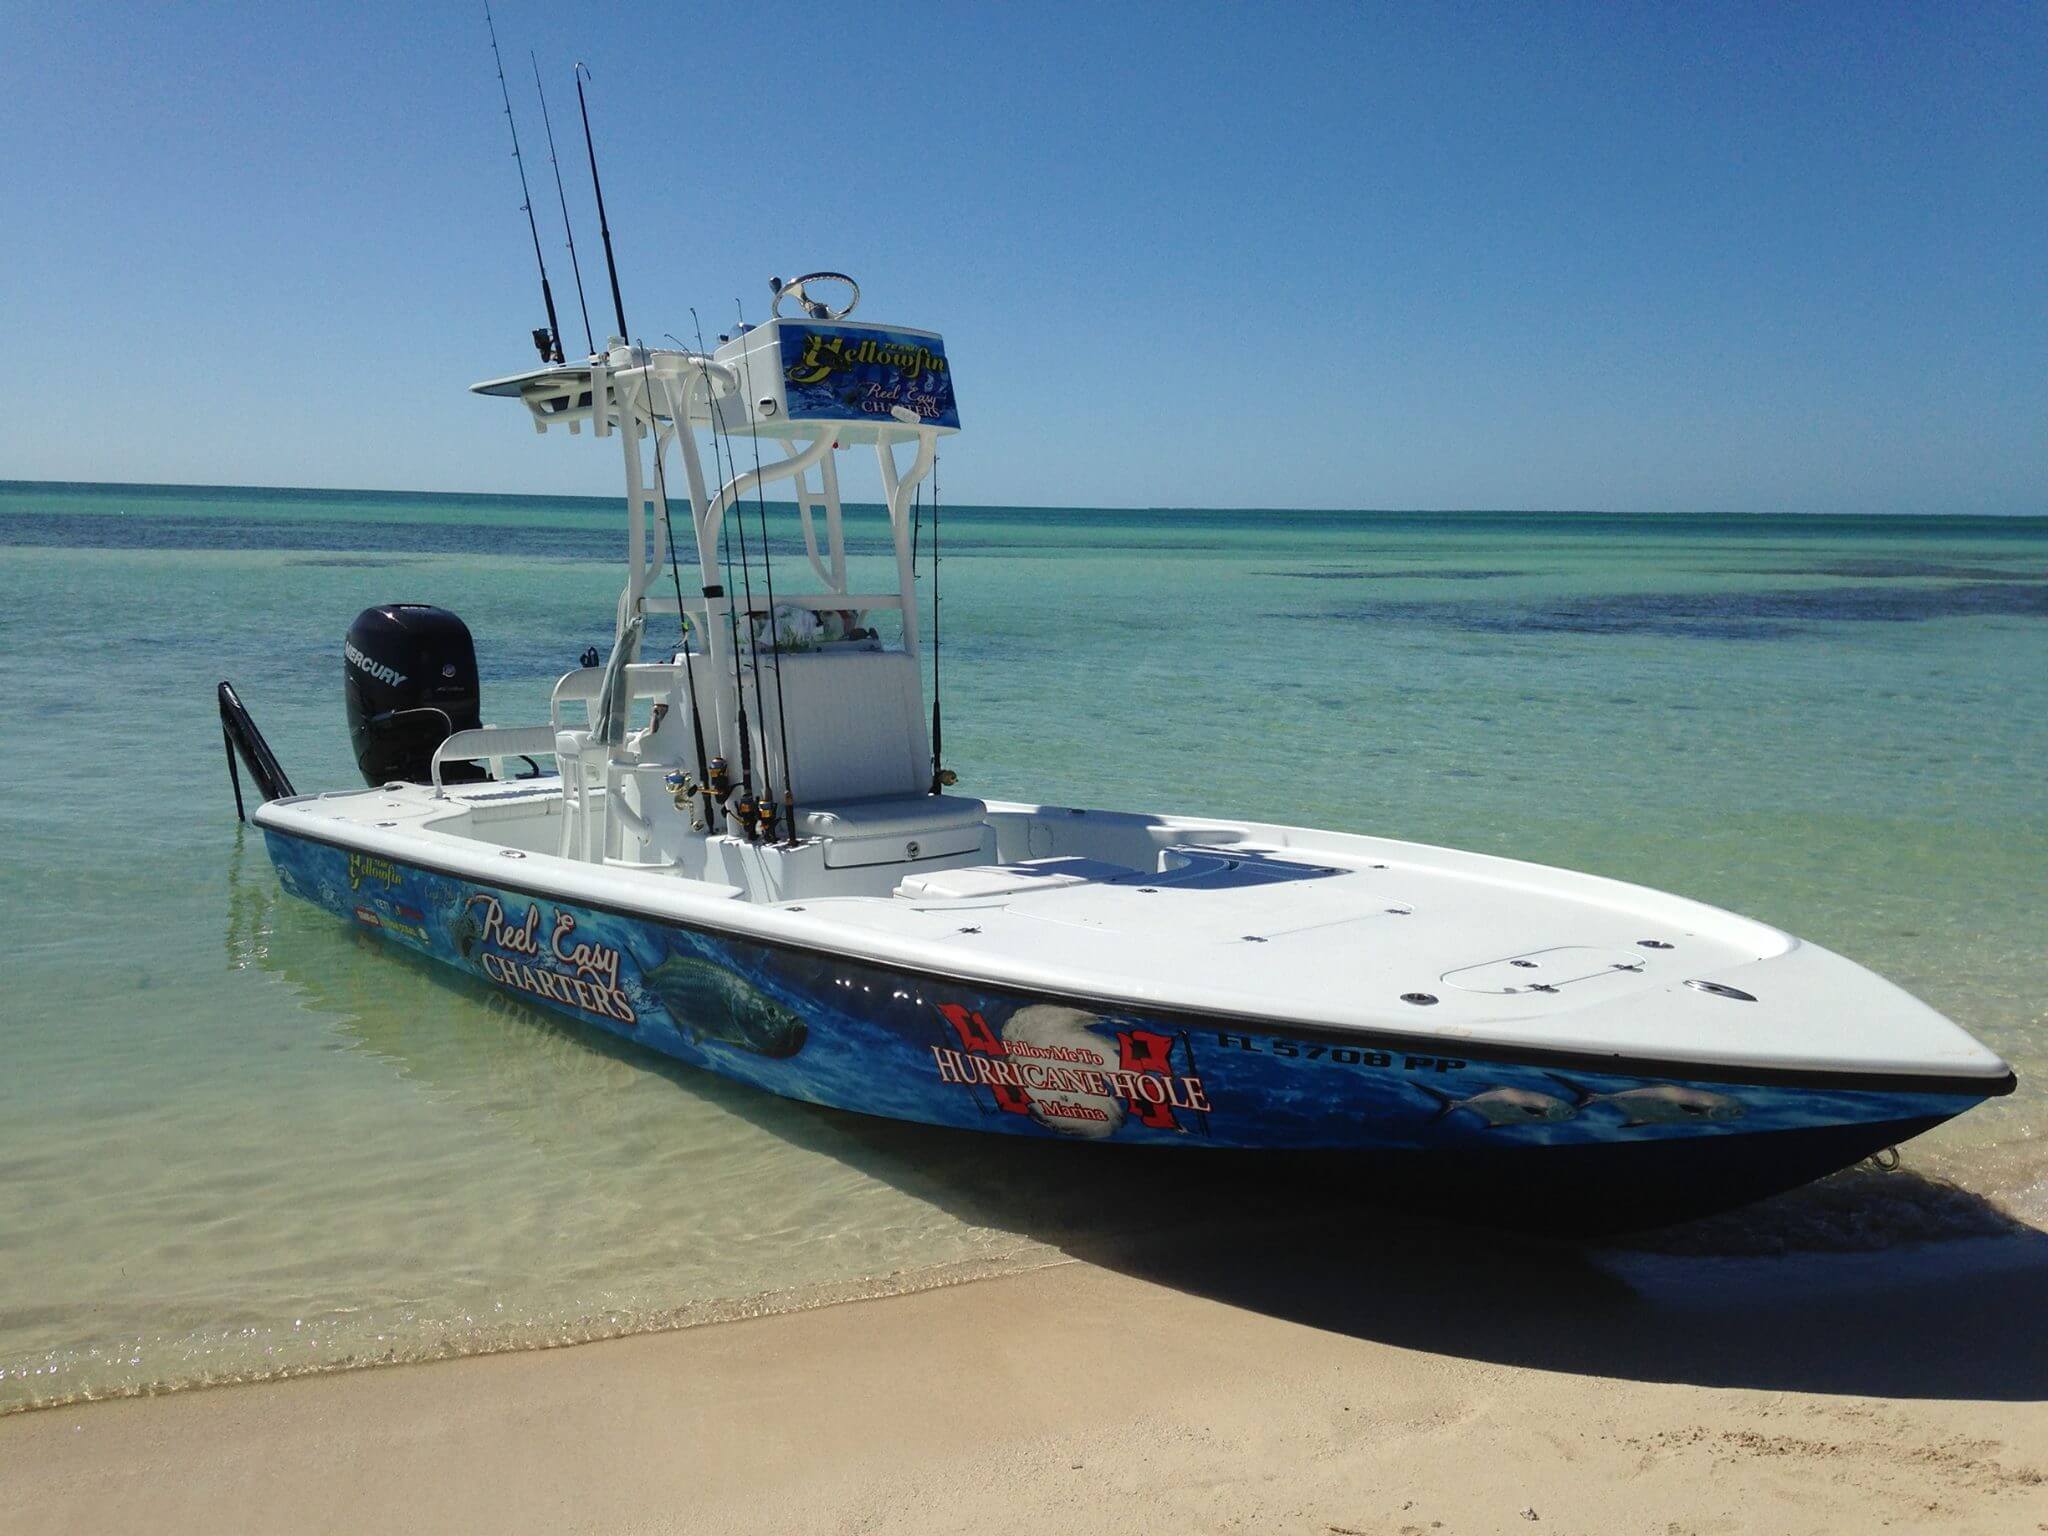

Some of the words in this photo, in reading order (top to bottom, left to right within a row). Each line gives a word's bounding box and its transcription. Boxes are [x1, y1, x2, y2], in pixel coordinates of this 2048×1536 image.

[789, 335, 945, 384] Yellowfin
[861, 382, 900, 400] Reel
[907, 386, 937, 409] Easy
[861, 400, 940, 418] CHTERS
[344, 640, 409, 688] MERCURY
[350, 853, 402, 891] Yellowfin
[465, 894, 537, 954] Reel
[551, 907, 619, 992] Easy
[481, 953, 636, 1024] CHARTERS
[1001, 1040, 1053, 1059] Follow
[1053, 1045, 1078, 1063] Me
[1078, 1049, 1104, 1067] To
[1218, 1032, 1263, 1052] FL
[1272, 1041, 1392, 1068] 5708
[1404, 1056, 1466, 1073] PP
[931, 1045, 1110, 1097] HURRICANE
[1107, 1071, 1211, 1112] HOLE
[1037, 1099, 1108, 1122] Marina
